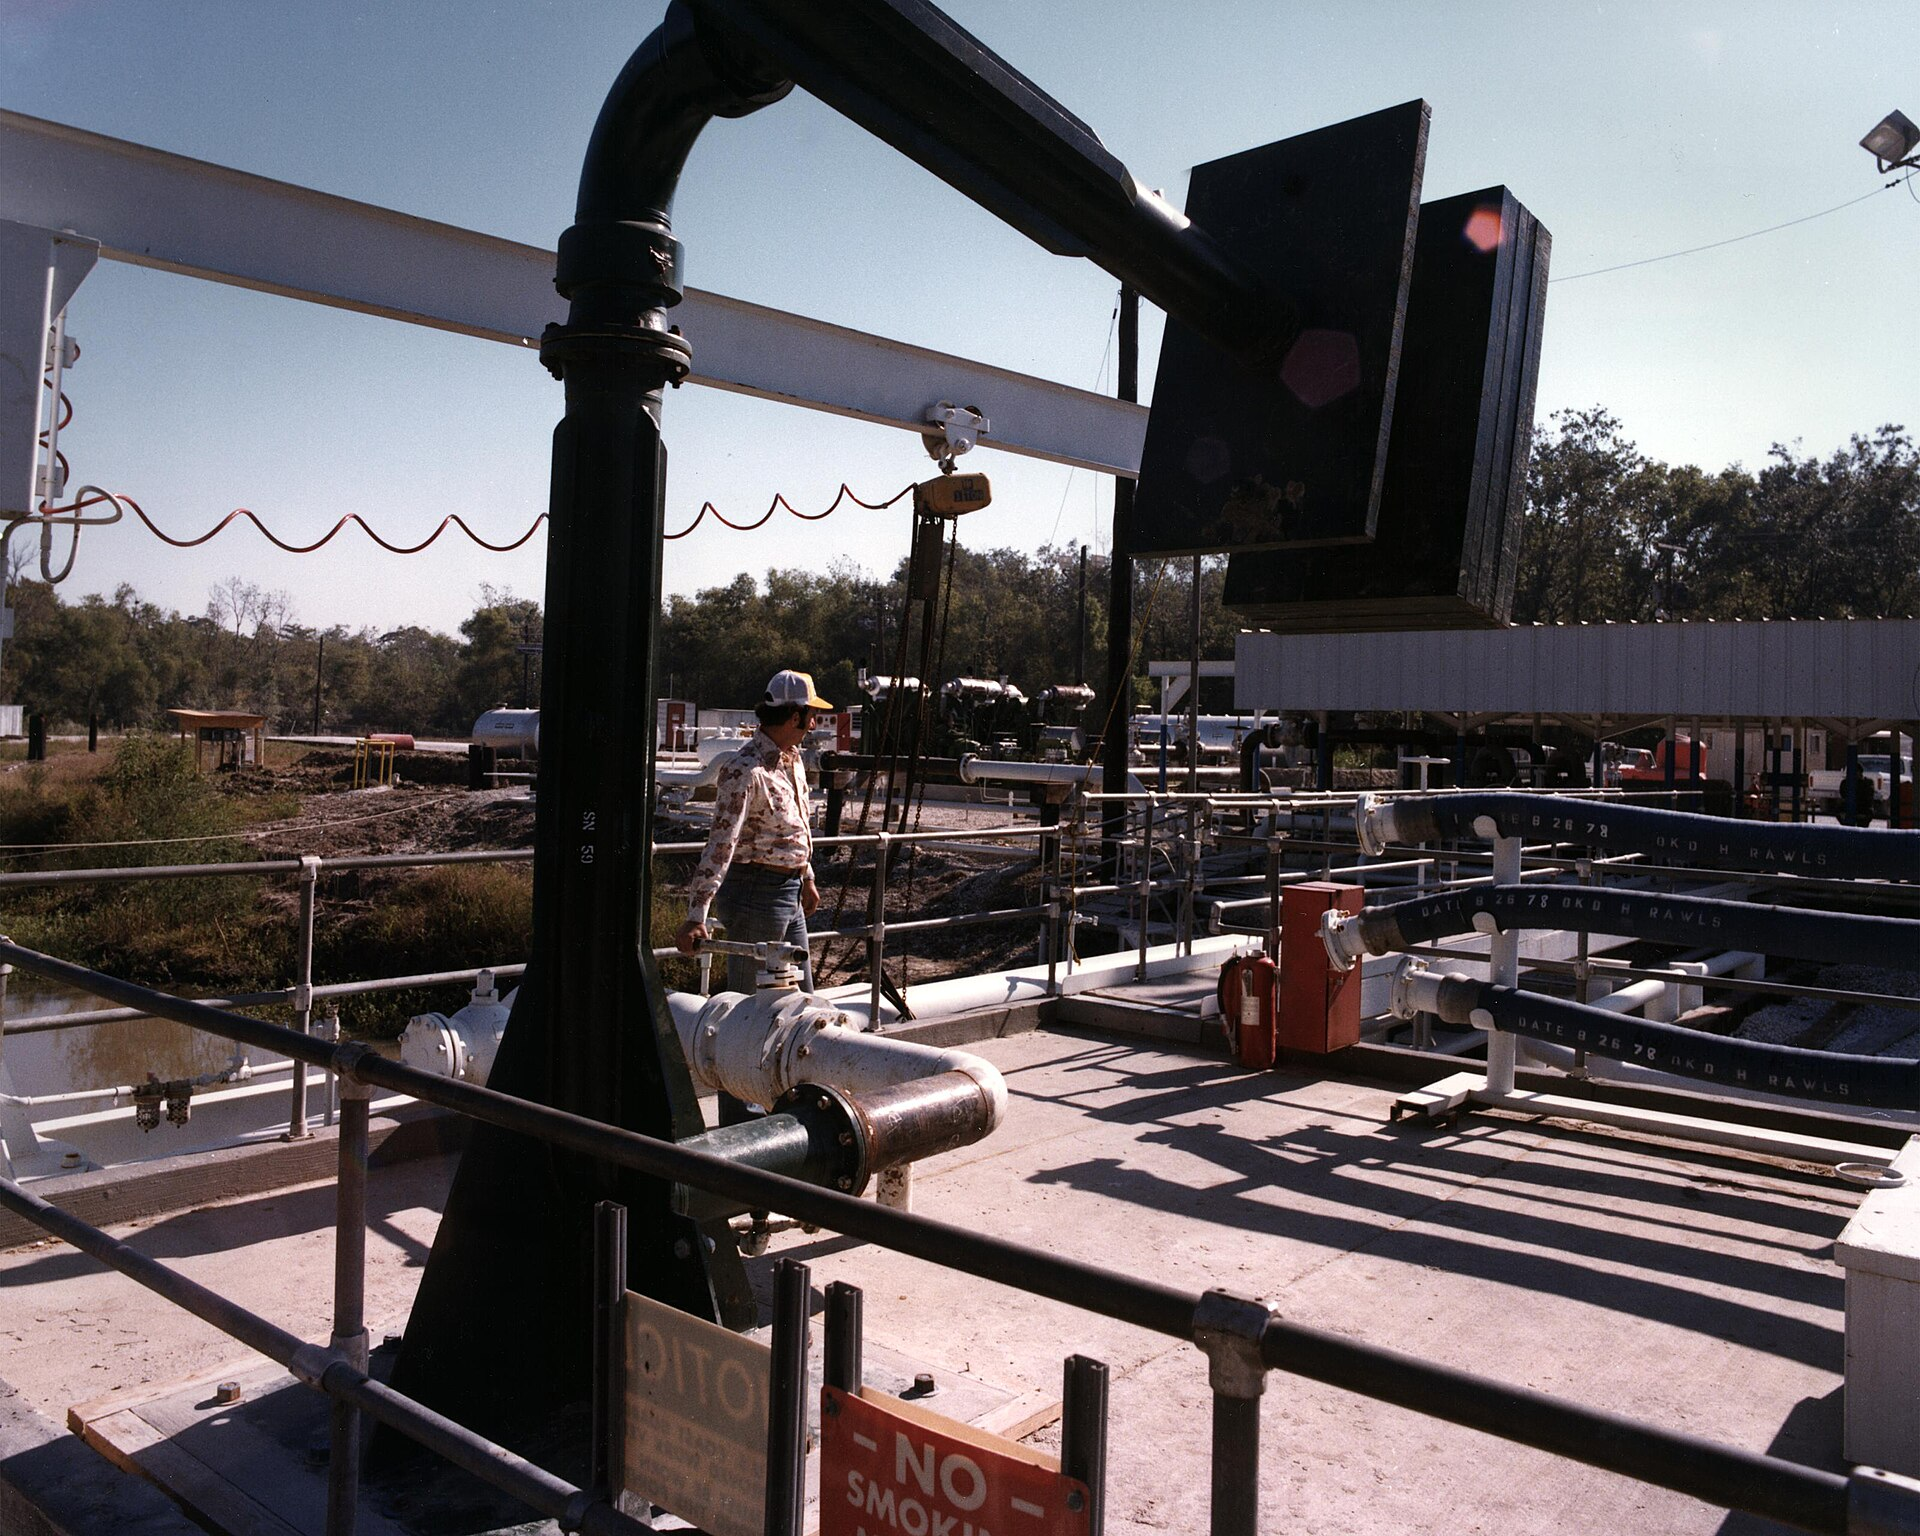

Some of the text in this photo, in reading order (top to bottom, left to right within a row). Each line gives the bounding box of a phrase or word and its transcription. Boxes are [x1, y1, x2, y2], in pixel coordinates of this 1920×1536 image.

[582, 811, 596, 831] SN
[1552, 817, 1574, 831] 26
[1585, 823, 1609, 838] 78
[1719, 844, 1729, 855] H
[1749, 847, 1827, 866] RAWLS
[1495, 894, 1515, 905] 26
[1527, 894, 1549, 909] 78
[1620, 903, 1631, 915] H
[1649, 906, 1722, 928] RAWLS
[1518, 1016, 1564, 1037] DATE
[1598, 1034, 1621, 1050] 26
[1633, 1043, 1657, 1061] 78
[1737, 1068, 1747, 1081] H
[1768, 1074, 1850, 1096] RAWLS
[895, 1431, 987, 1511] NO
[846, 1469, 991, 1536] SMOK
